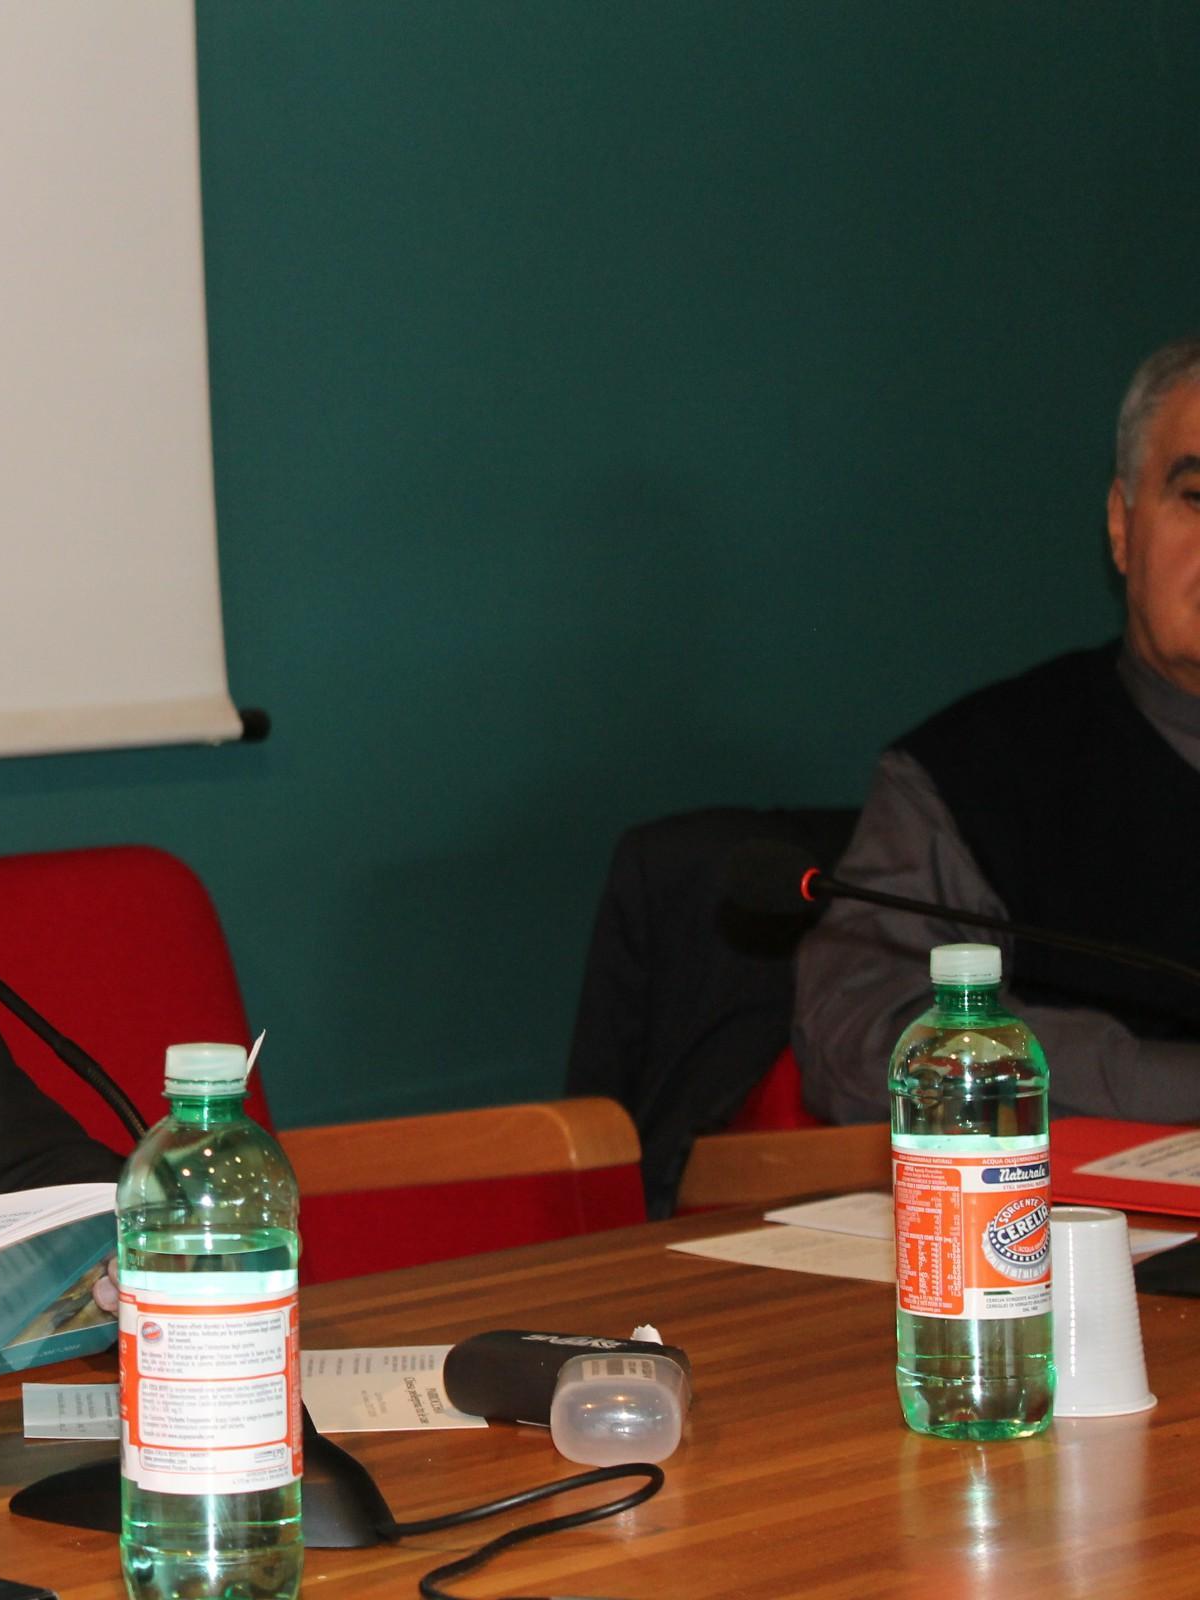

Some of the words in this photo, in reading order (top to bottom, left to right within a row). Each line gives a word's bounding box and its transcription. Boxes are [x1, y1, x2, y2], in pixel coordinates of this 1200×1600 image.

[982, 1158, 1004, 1166] ACQUA
[999, 1165, 1047, 1182] Naturale
[999, 1198, 1039, 1223] SORGENTE
[997, 1205, 1049, 1245] CERELIA
